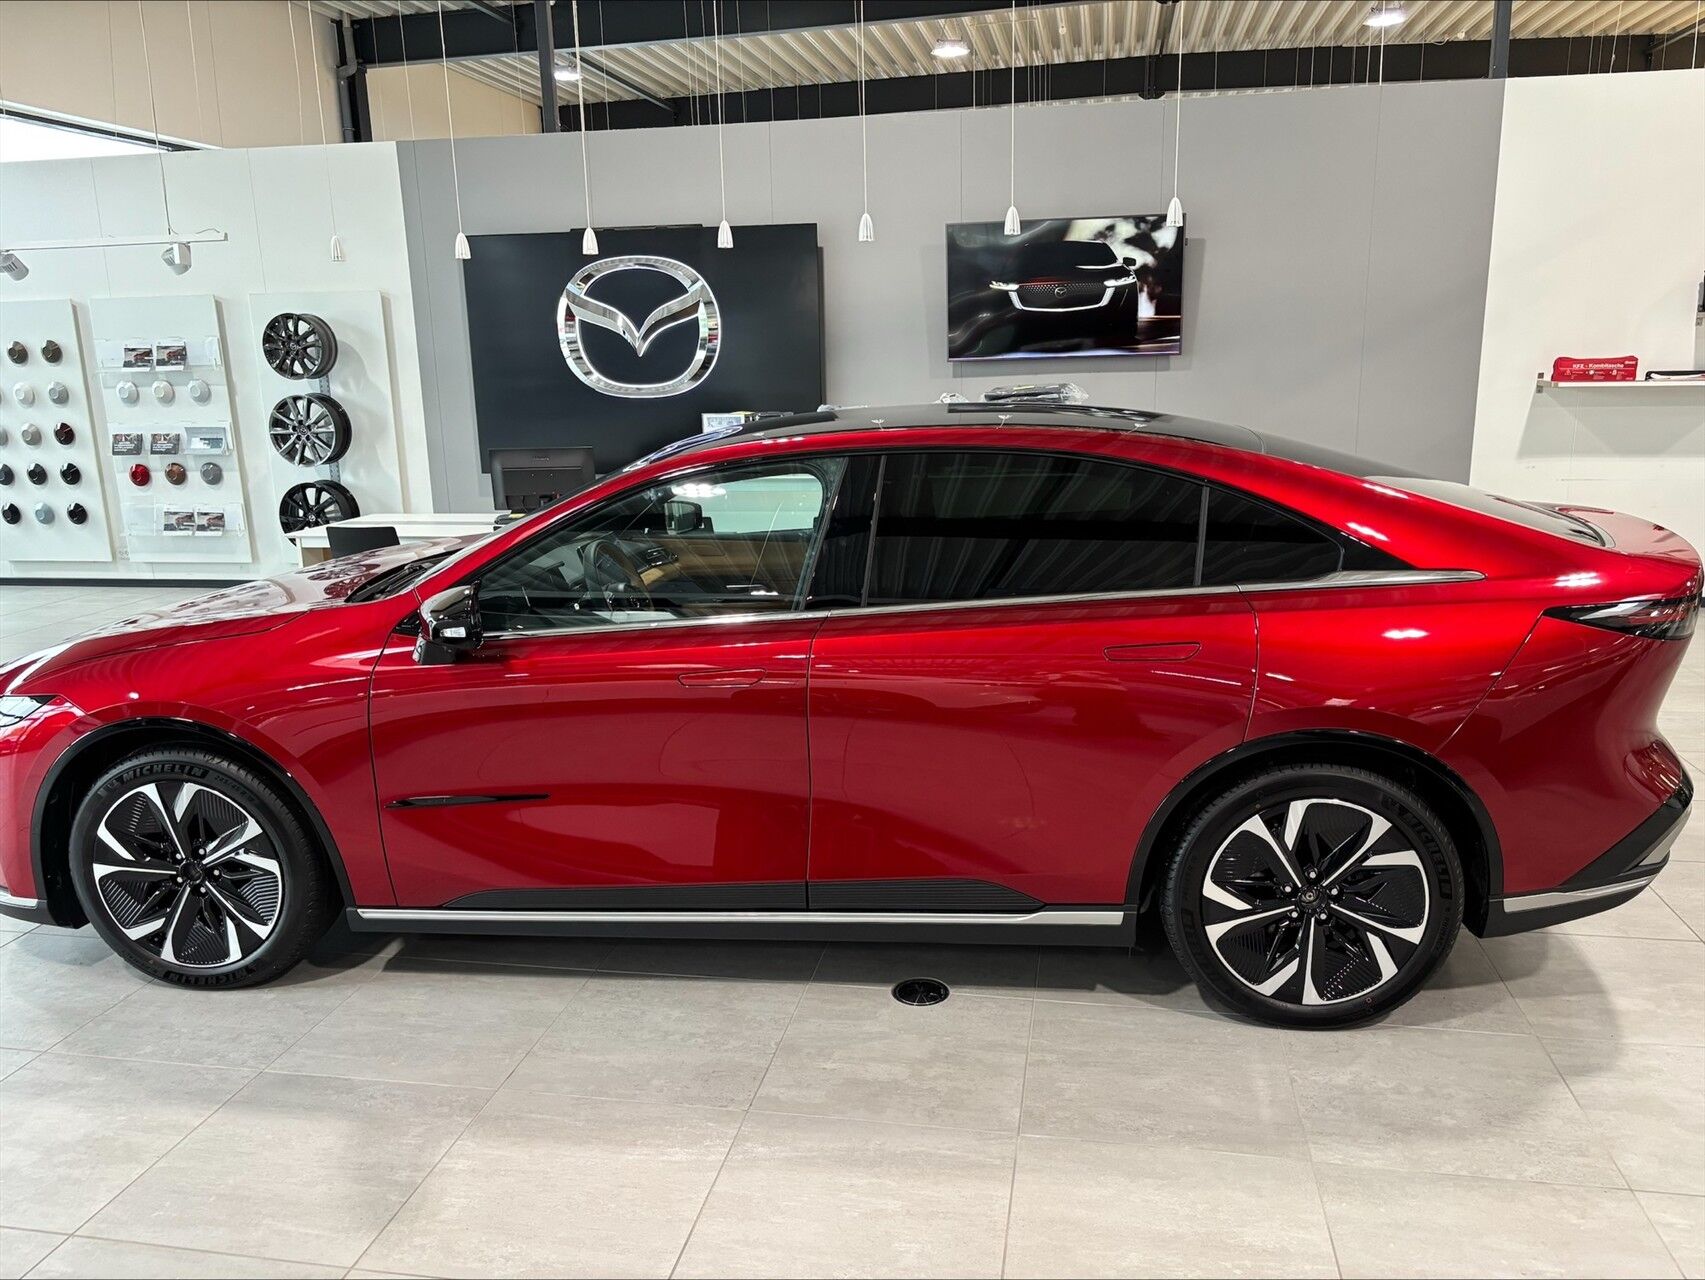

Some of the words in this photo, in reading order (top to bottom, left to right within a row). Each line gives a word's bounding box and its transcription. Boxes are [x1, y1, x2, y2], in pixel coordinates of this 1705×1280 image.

[122, 764, 204, 782] MICHELIN
[1402, 810, 1451, 894] MICHELIN
[168, 969, 247, 985] MICHELIN
